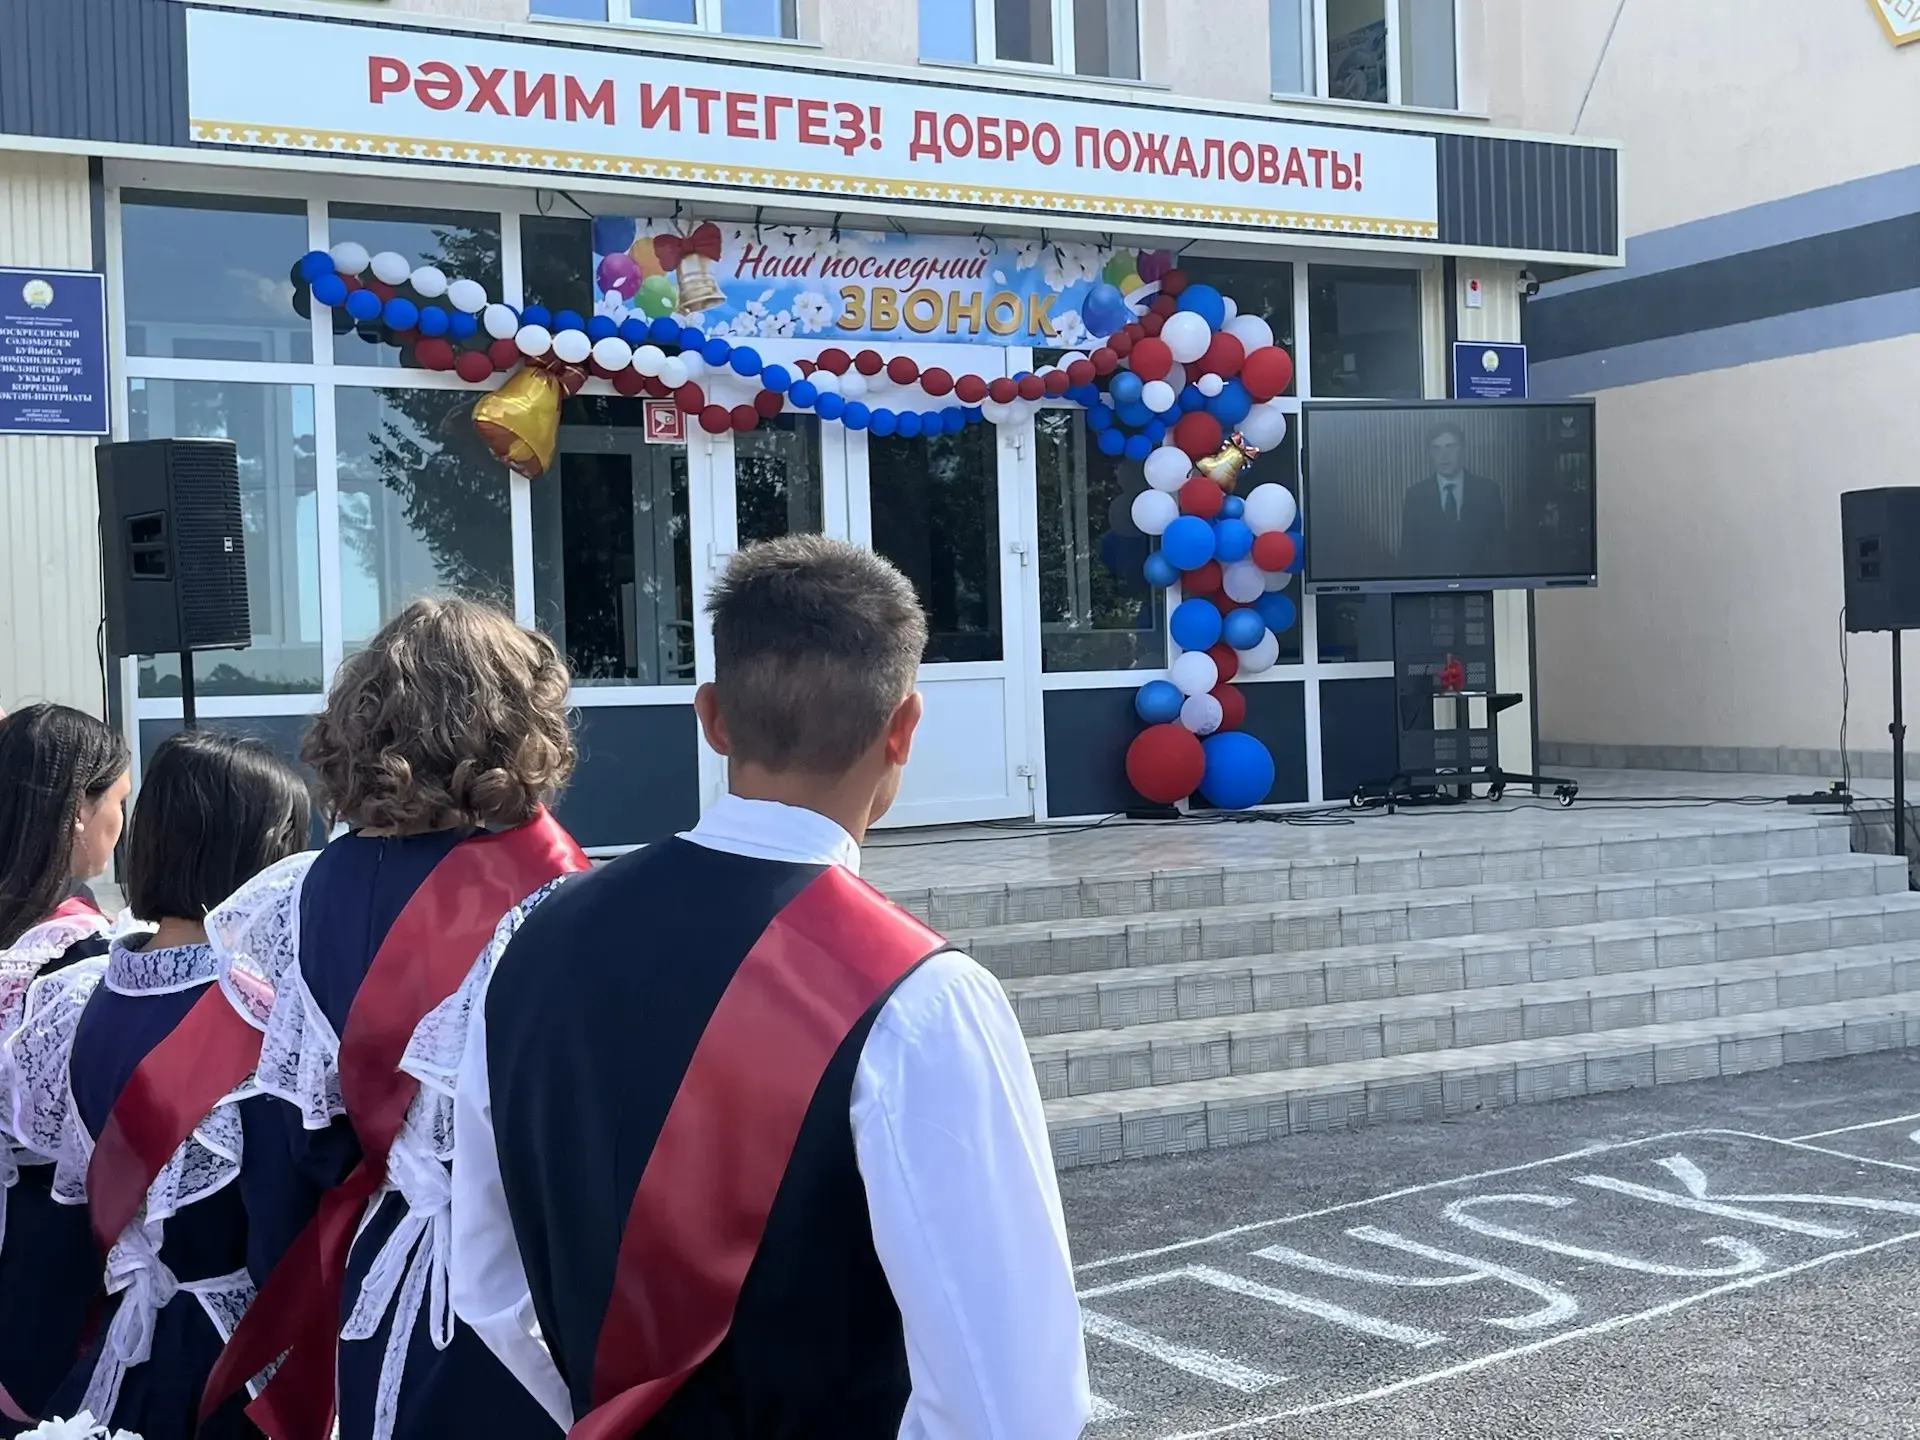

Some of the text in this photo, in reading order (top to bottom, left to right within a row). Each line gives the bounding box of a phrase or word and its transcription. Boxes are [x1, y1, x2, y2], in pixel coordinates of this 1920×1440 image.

[368, 56, 1363, 192] РӘХИМ ИТЕГЕҘ! ДОБРО ПОЖАЛОВАТЬ!
[734, 243, 990, 293] Наш последний
[835, 285, 1060, 339] ЗВОНОК
